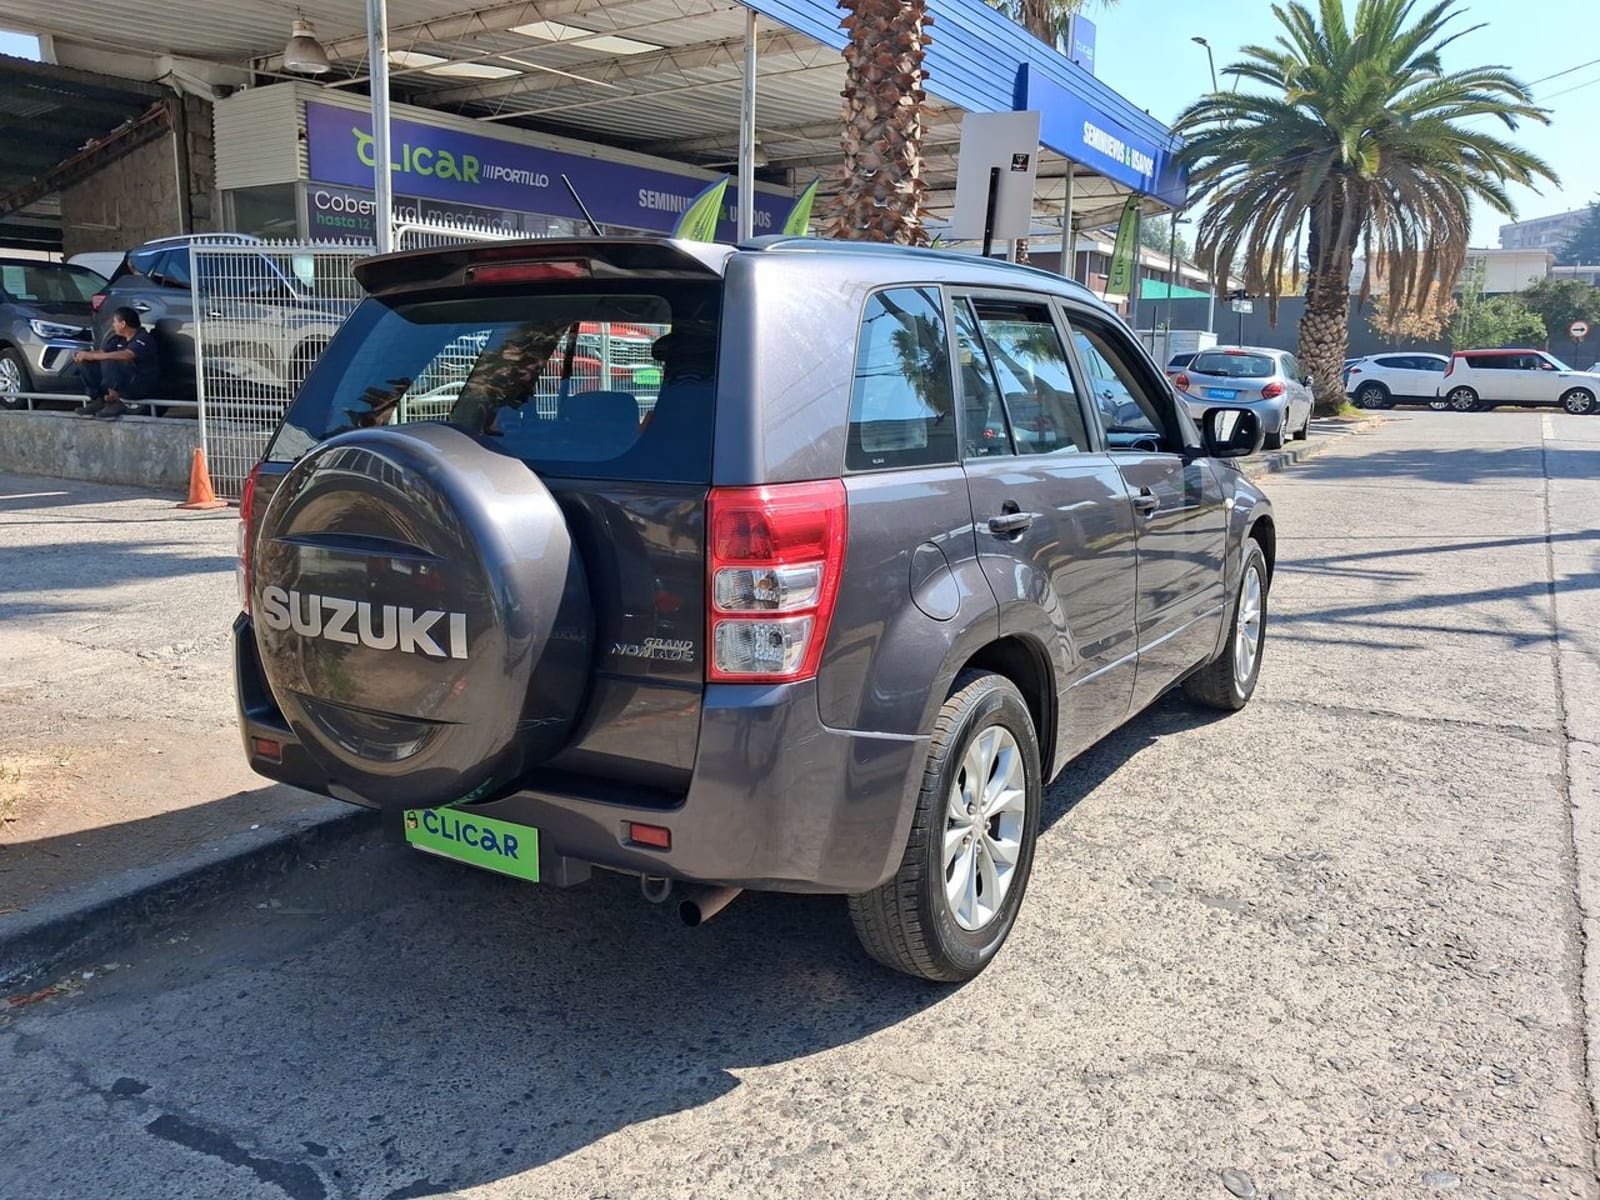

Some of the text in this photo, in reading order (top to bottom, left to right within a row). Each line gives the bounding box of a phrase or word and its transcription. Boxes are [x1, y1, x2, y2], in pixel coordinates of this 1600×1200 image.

[316, 211, 370, 230] hasta 12
[638, 188, 695, 213] SEMINU
[729, 205, 772, 228] UDOS
[262, 585, 469, 660] SUZUKI
[644, 637, 694, 651] GRAND
